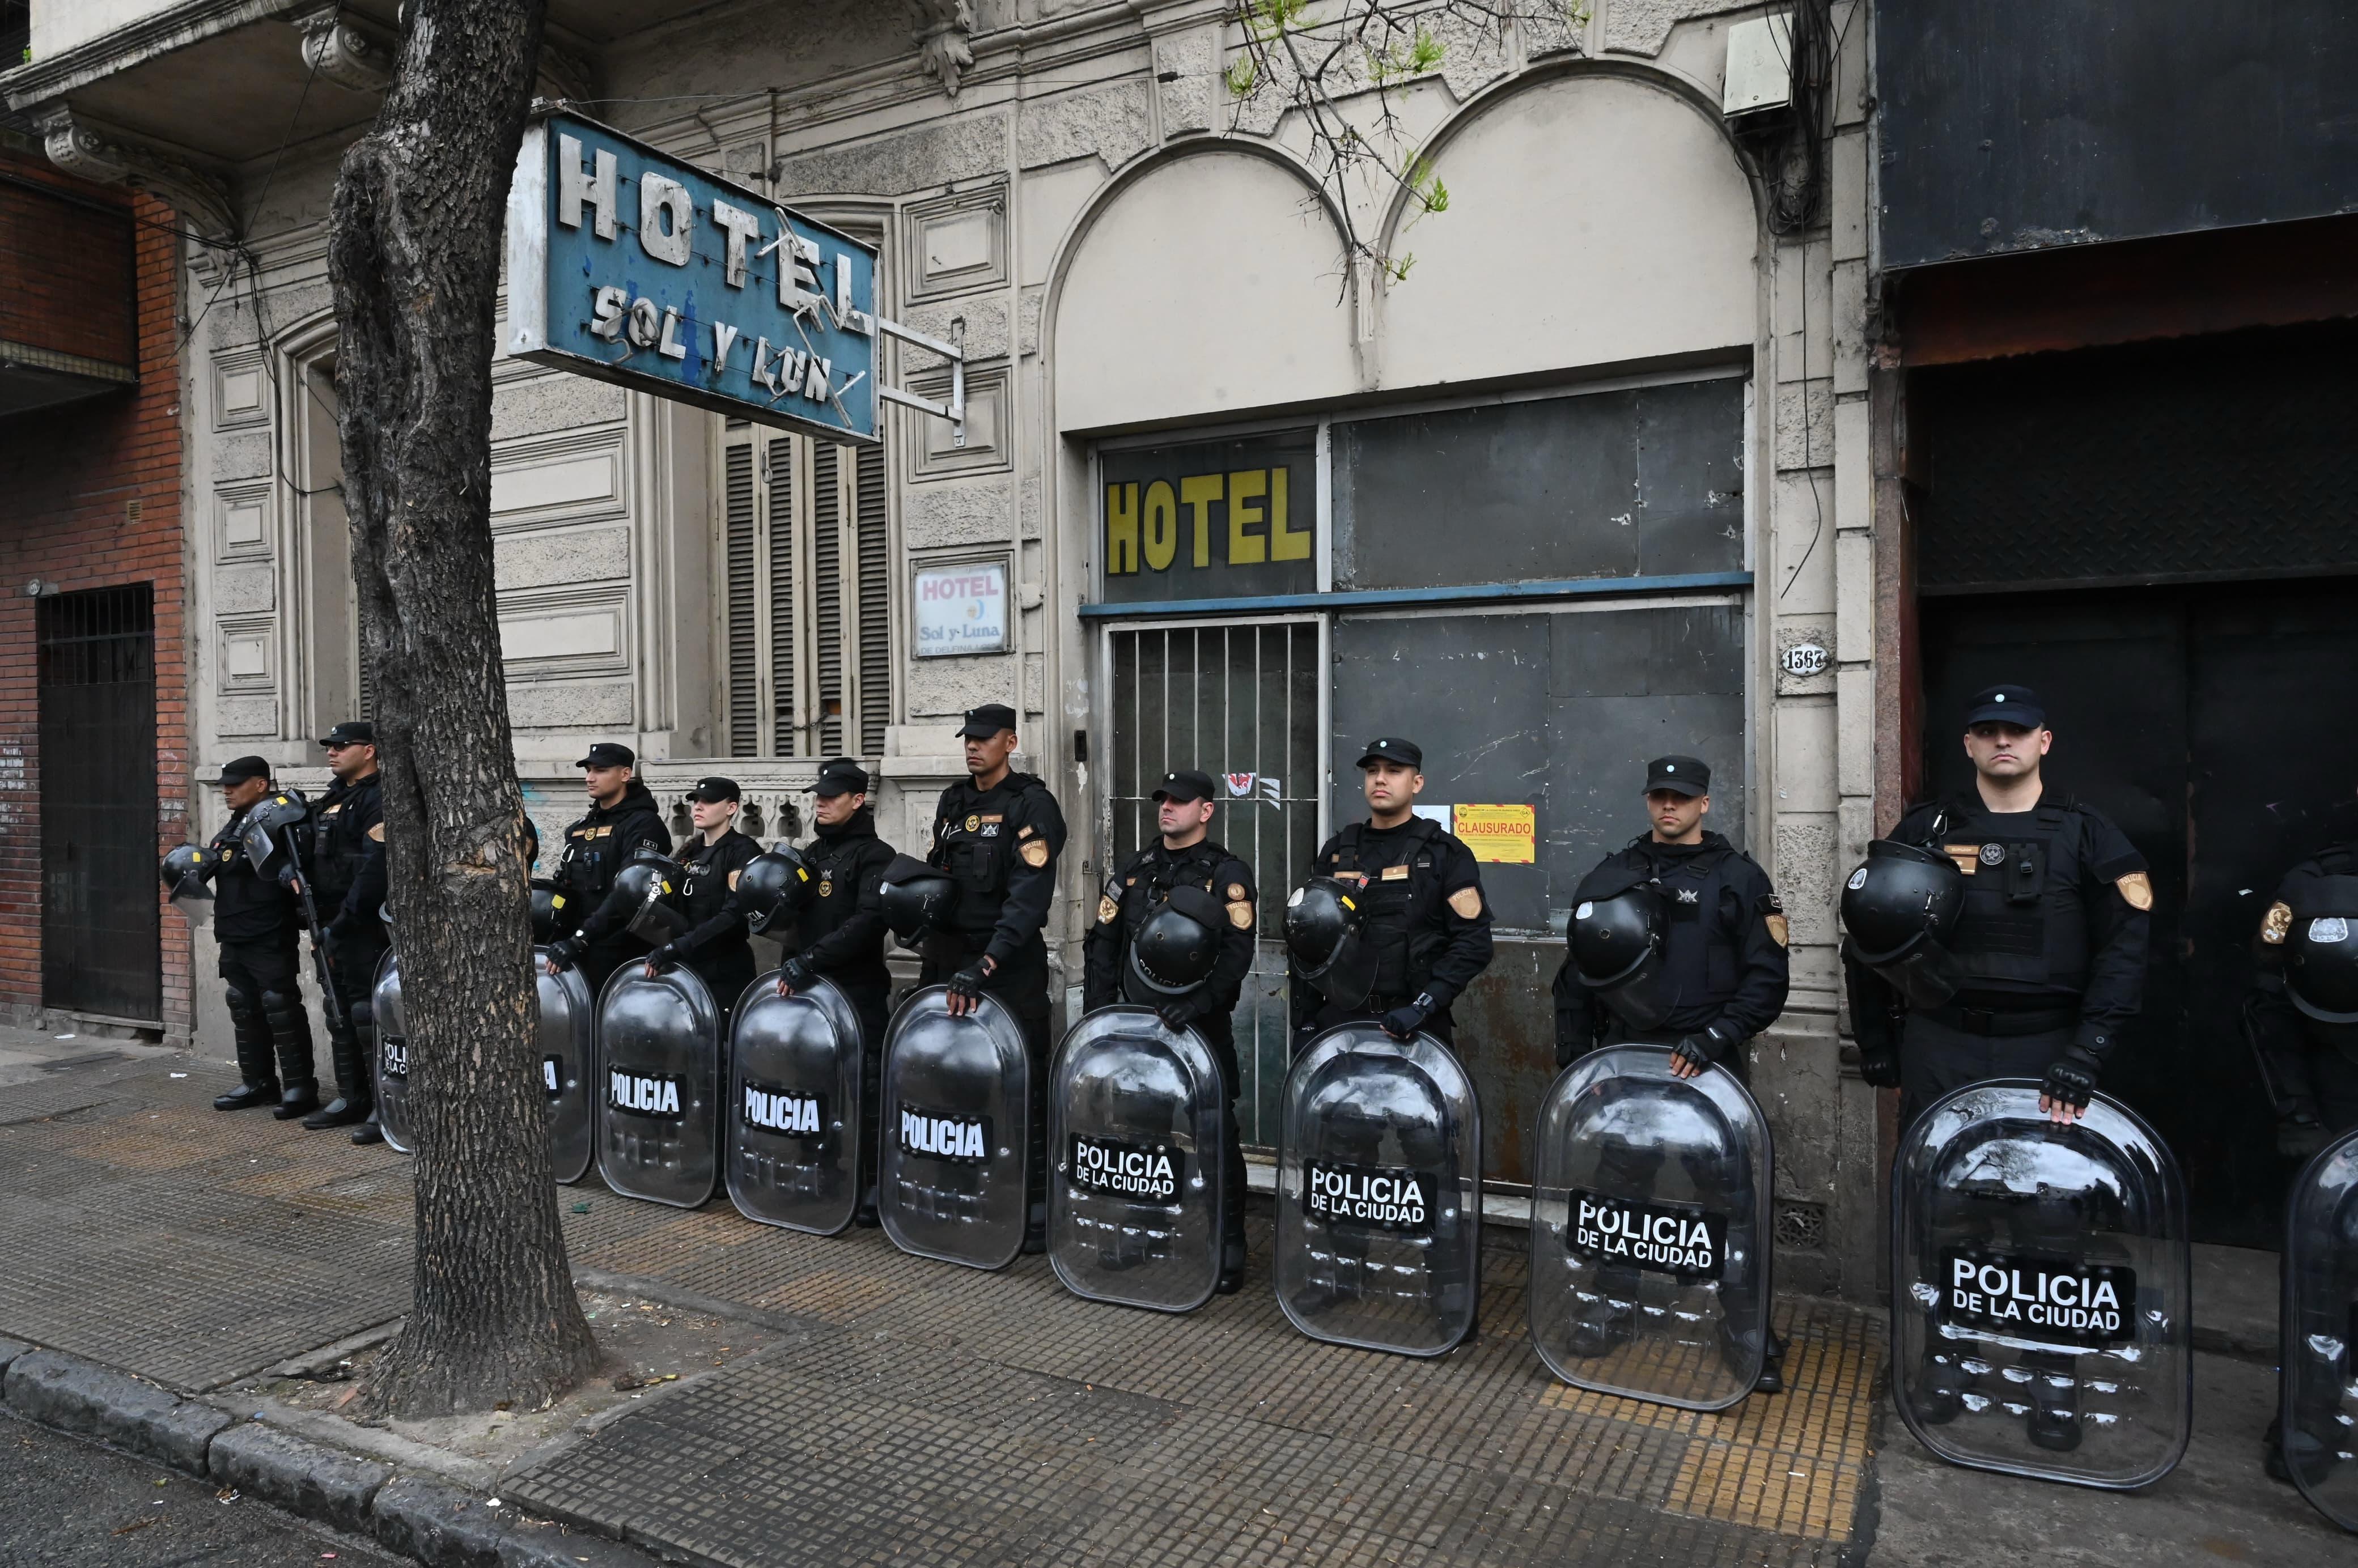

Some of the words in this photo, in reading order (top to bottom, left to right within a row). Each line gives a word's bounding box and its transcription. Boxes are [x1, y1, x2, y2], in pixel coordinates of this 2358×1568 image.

[560, 133, 875, 337] HOTEL
[591, 285, 686, 359] SOL
[715, 321, 738, 371] Y
[752, 336, 832, 402] LUN
[1108, 468, 1311, 573] HOTEL
[923, 575, 999, 601] HOTEL
[919, 625, 944, 640] Sol
[949, 628, 957, 641] y
[962, 624, 1000, 638] Luna
[936, 645, 972, 653] DELFINA
[1023, 840, 1041, 851] POLICIA
[1458, 822, 1530, 834] CLAUSURADO
[1452, 889, 1471, 901] POLICIA
[2120, 874, 2141, 885] POLICIA
[384, 1042, 406, 1063] POLI
[611, 1071, 680, 1112] POLICIA
[745, 1086, 820, 1132] POLICIA
[901, 1110, 985, 1157] POLICIA
[1078, 1141, 1174, 1179] POLICIA
[1077, 1165, 1089, 1183] DE
[1092, 1170, 1108, 1187] LA
[1112, 1174, 1174, 1195] CIUDAD
[1312, 1167, 1424, 1205] POLICIA
[1311, 1192, 1328, 1211] DE
[1331, 1197, 1351, 1216] LA
[1355, 1201, 1424, 1223] CIUDAD
[1579, 1200, 1712, 1250] POLICIA
[1577, 1227, 1600, 1248] DE
[1604, 1234, 1628, 1256] LA
[1634, 1241, 1712, 1268] CIUDAD
[1954, 1258, 2120, 1309] POLICIA
[1953, 1289, 1982, 1312] DE
[1990, 1297, 2022, 1320] LA
[2028, 1303, 2120, 1331] CIUDAD
